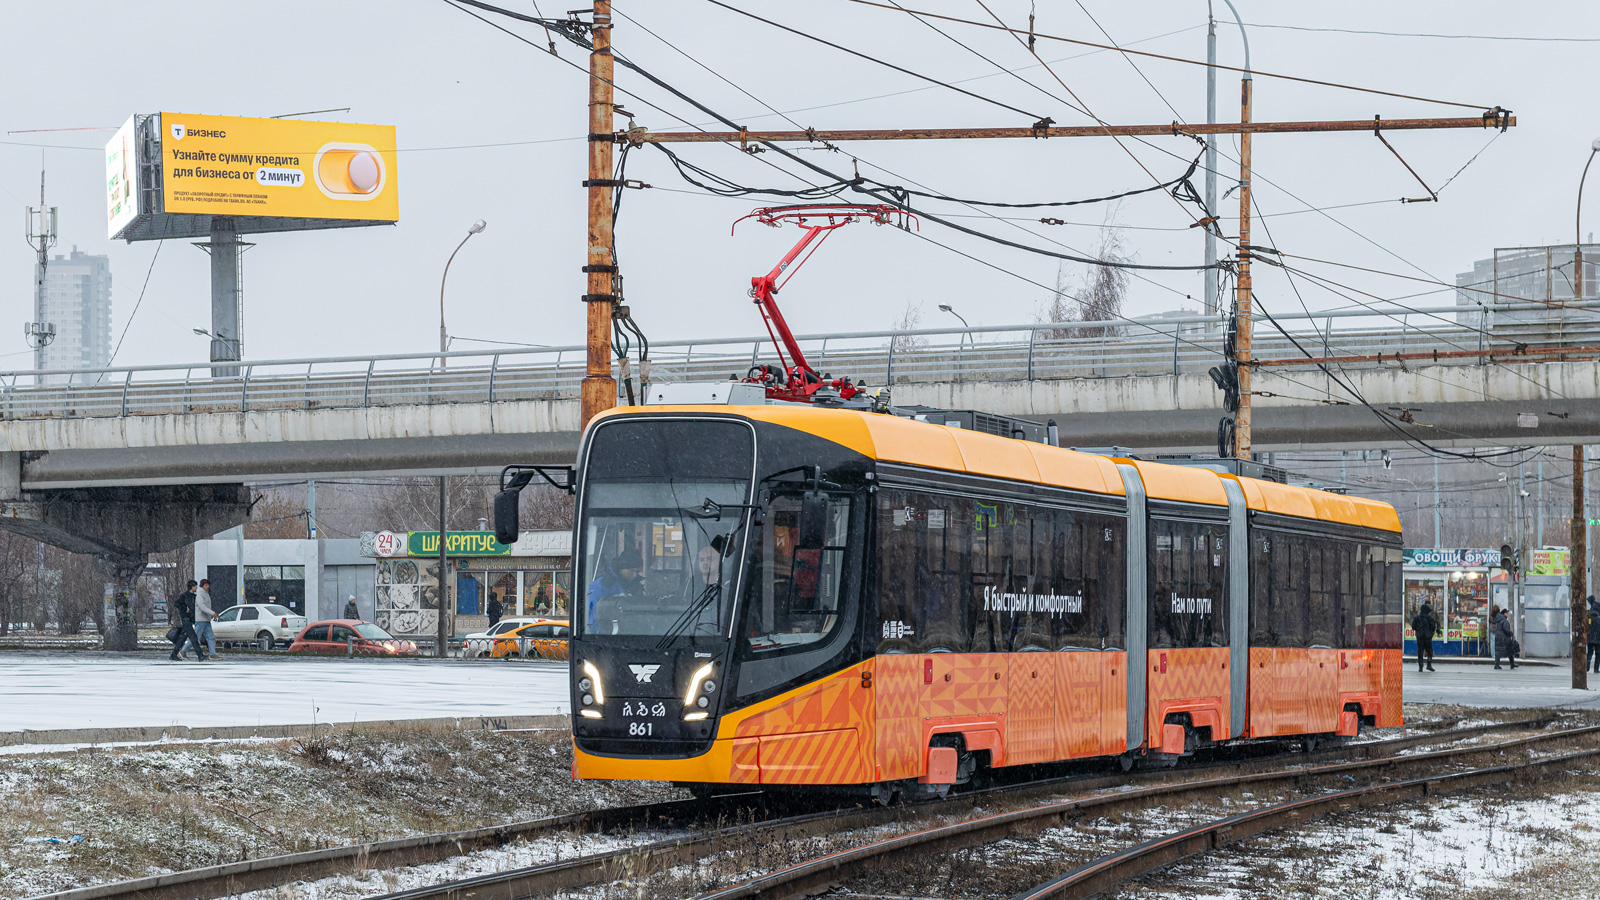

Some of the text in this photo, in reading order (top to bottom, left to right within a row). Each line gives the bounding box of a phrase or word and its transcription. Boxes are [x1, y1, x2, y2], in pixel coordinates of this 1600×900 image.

[187, 129, 226, 138] БИЗНЕС
[172, 149, 300, 166] Узнайте сумму кредита
[173, 166, 301, 184] для бизнеса от 2 минут
[378, 534, 392, 548] 24
[1414, 553, 1502, 564] ОВОЩИ ФРУКТ
[984, 585, 1082, 619] Я быстрый и комфортный
[1171, 592, 1212, 620] Нам по пути
[629, 722, 653, 736] 861
